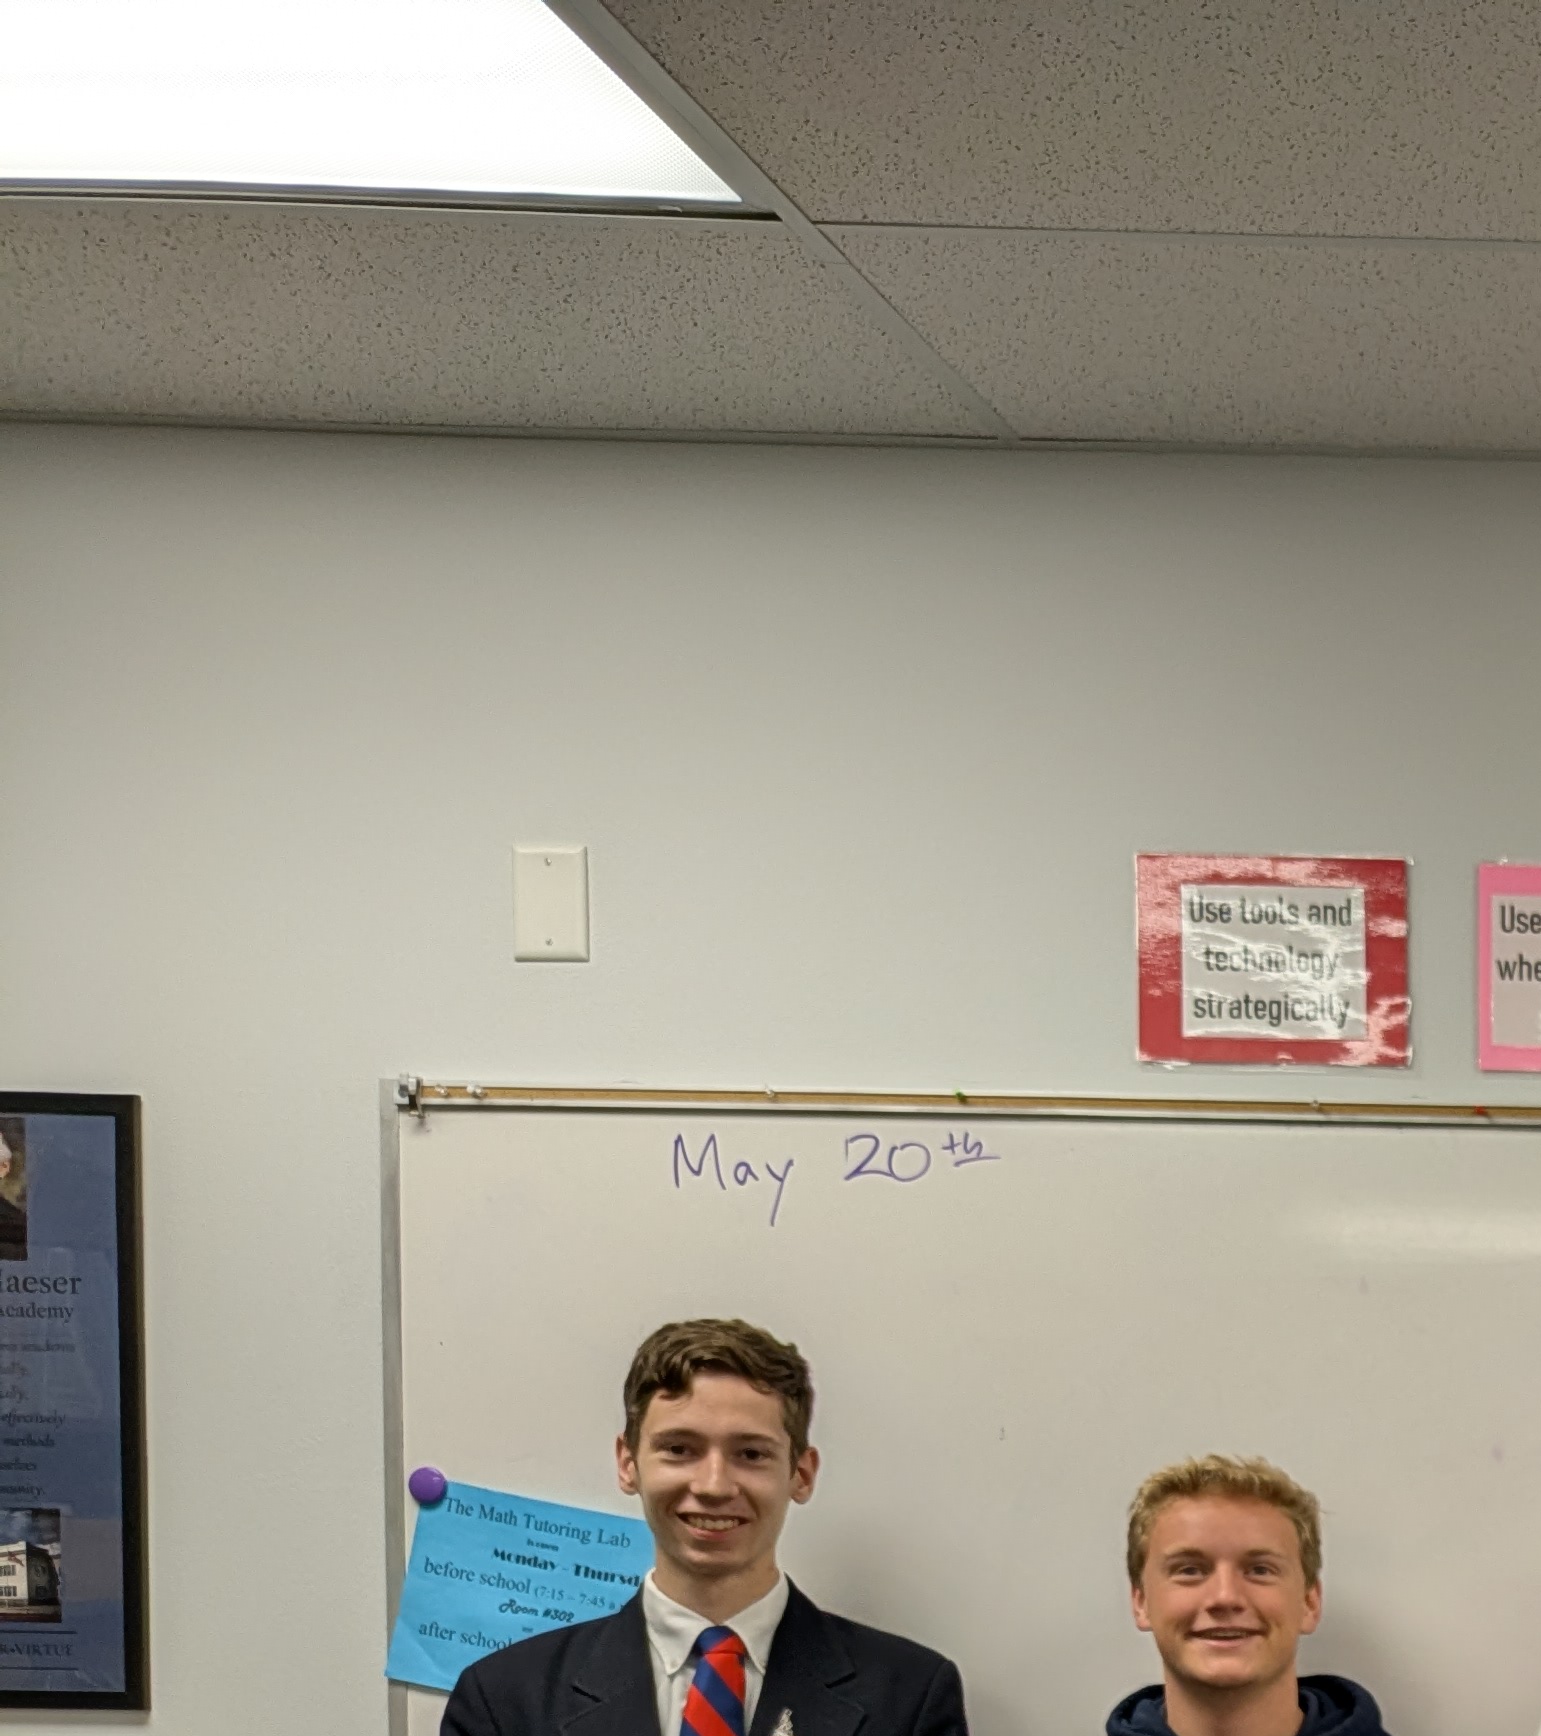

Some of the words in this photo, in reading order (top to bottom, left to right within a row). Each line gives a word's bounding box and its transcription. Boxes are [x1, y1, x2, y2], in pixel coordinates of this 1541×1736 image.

[1189, 895, 1232, 925] Use
[1241, 899, 1300, 926] tools
[1307, 899, 1353, 927] and
[1203, 947, 1341, 976] technology
[1193, 994, 1350, 1026] strategically
[673, 1133, 794, 1227] May
[843, 1131, 1001, 1183] 20th
[443, 1497, 474, 1518] The
[479, 1504, 518, 1527] Math
[523, 1513, 592, 1545] Tutoring
[597, 1528, 631, 1548] Lab
[423, 1557, 475, 1583] before
[479, 1573, 531, 1595] school
[491, 1548, 558, 1571] Monday
[571, 1565, 641, 1588] Thursd
[498, 1599, 539, 1617] Room
[542, 1608, 575, 1623] #302
[418, 1622, 457, 1642] after
